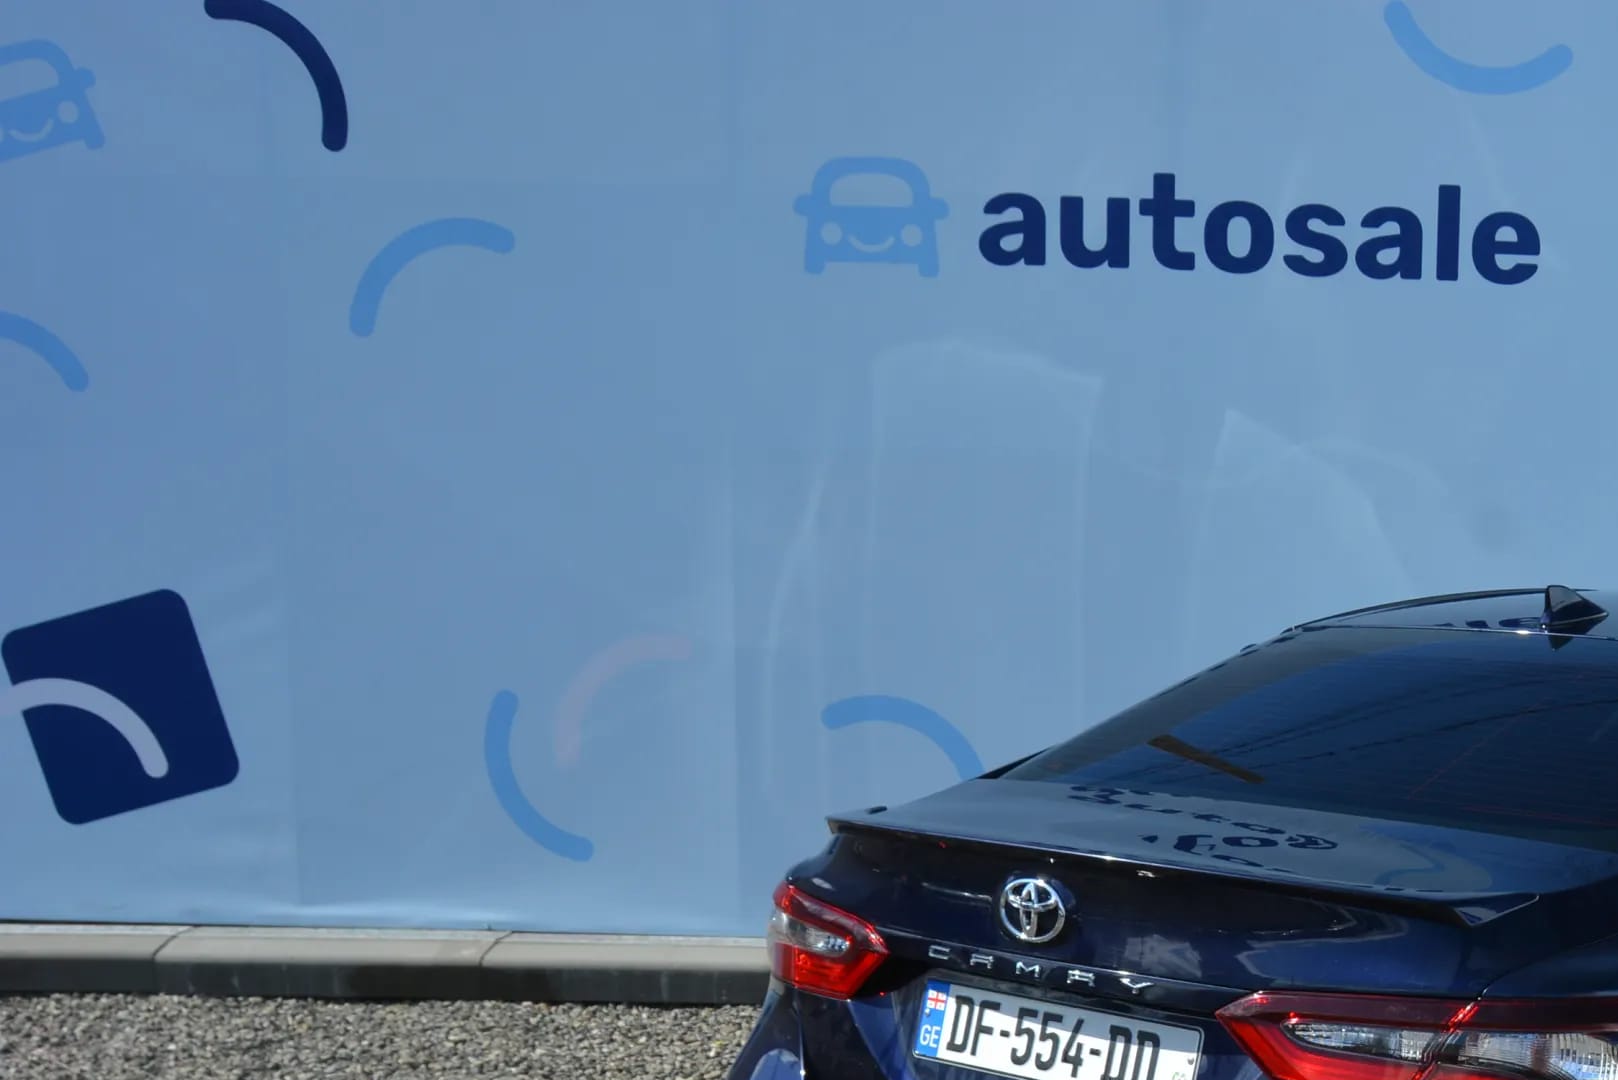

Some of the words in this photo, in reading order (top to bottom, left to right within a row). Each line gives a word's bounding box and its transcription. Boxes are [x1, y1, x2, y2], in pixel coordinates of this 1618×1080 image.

[978, 172, 1541, 285] autosale
[928, 944, 1154, 995] CAMRY
[919, 1024, 941, 1048] GE
